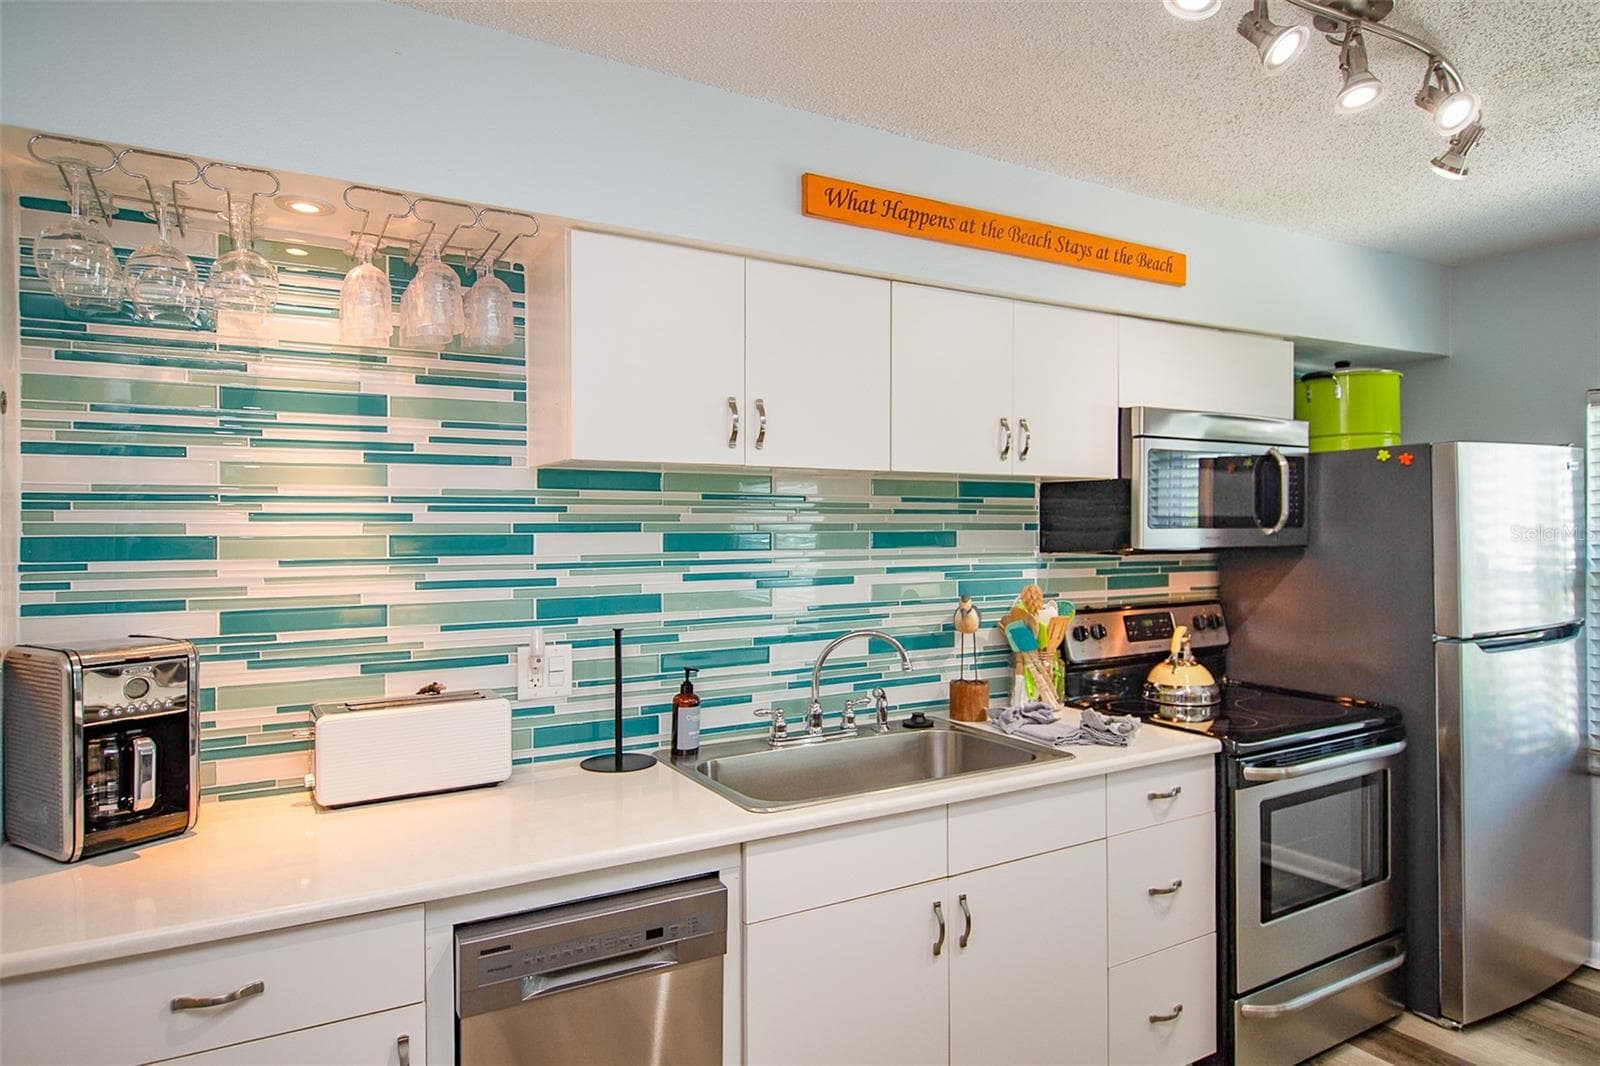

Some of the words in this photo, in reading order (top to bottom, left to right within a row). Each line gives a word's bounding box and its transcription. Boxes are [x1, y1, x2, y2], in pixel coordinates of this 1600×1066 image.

[824, 187, 877, 215] What
[881, 199, 956, 231] Happens
[959, 219, 976, 234] at
[980, 219, 1005, 240] the
[1007, 225, 1053, 250] Beach
[1054, 235, 1093, 262] Stays
[1095, 247, 1110, 261] at
[1113, 246, 1134, 265] the
[1136, 252, 1174, 273] Beach
